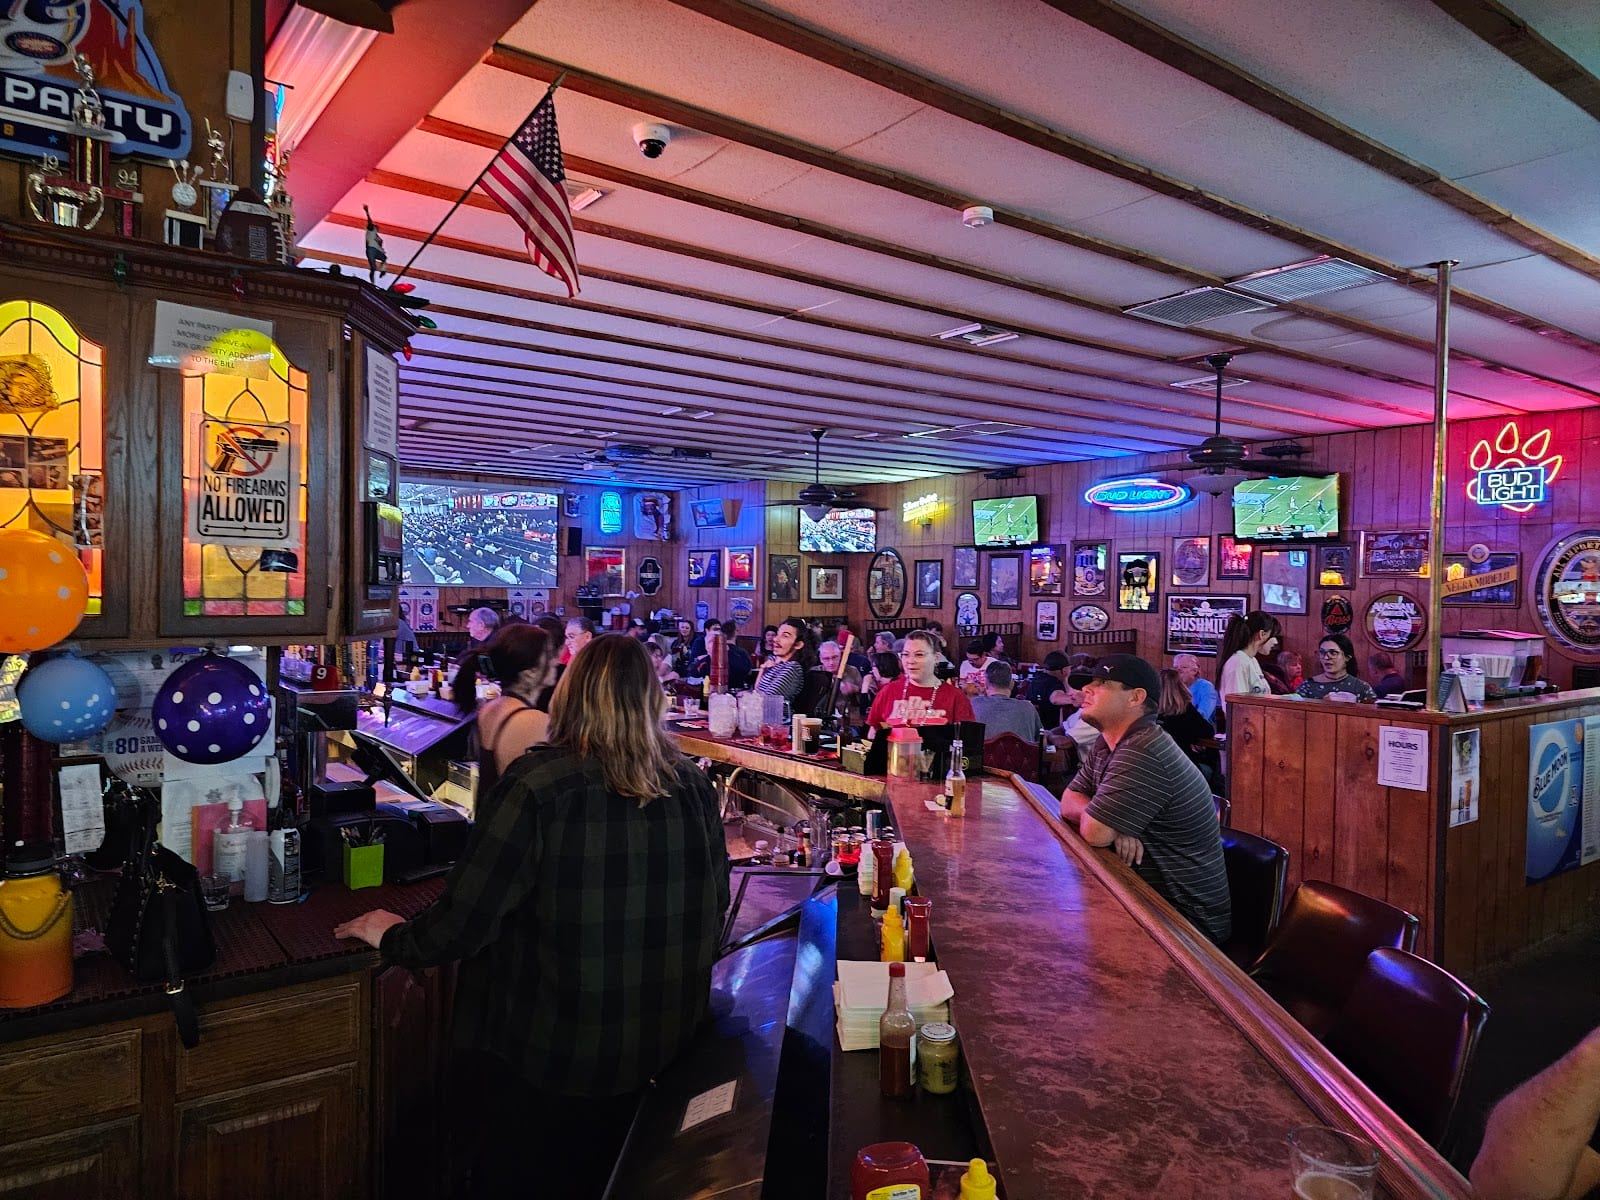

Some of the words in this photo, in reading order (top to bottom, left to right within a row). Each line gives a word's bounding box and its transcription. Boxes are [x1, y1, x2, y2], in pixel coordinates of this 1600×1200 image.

[4, 77, 173, 143] PATY
[176, 328, 201, 340] MORE
[196, 322, 220, 332] PARTY
[191, 354, 202, 363] TO
[204, 357, 218, 366] THE
[220, 360, 235, 369] BILL
[229, 351, 255, 361] ADDED
[203, 475, 221, 493] NO
[226, 477, 286, 497] FIREARMS
[1487, 471, 1533, 489] BUD
[1094, 490, 1128, 501] BUD
[1129, 489, 1175, 500] LIGHT
[1480, 484, 1540, 501] LIGHT
[202, 494, 285, 524] ALLOWED
[1446, 579, 1473, 593] NEGRA
[1475, 571, 1511, 587] MODELO
[316, 667, 328, 680] 9
[115, 737, 139, 755] 80
[1388, 740, 1419, 751] HOURS
[1533, 769, 1551, 800] BLUE
[1551, 751, 1568, 779] MOON
